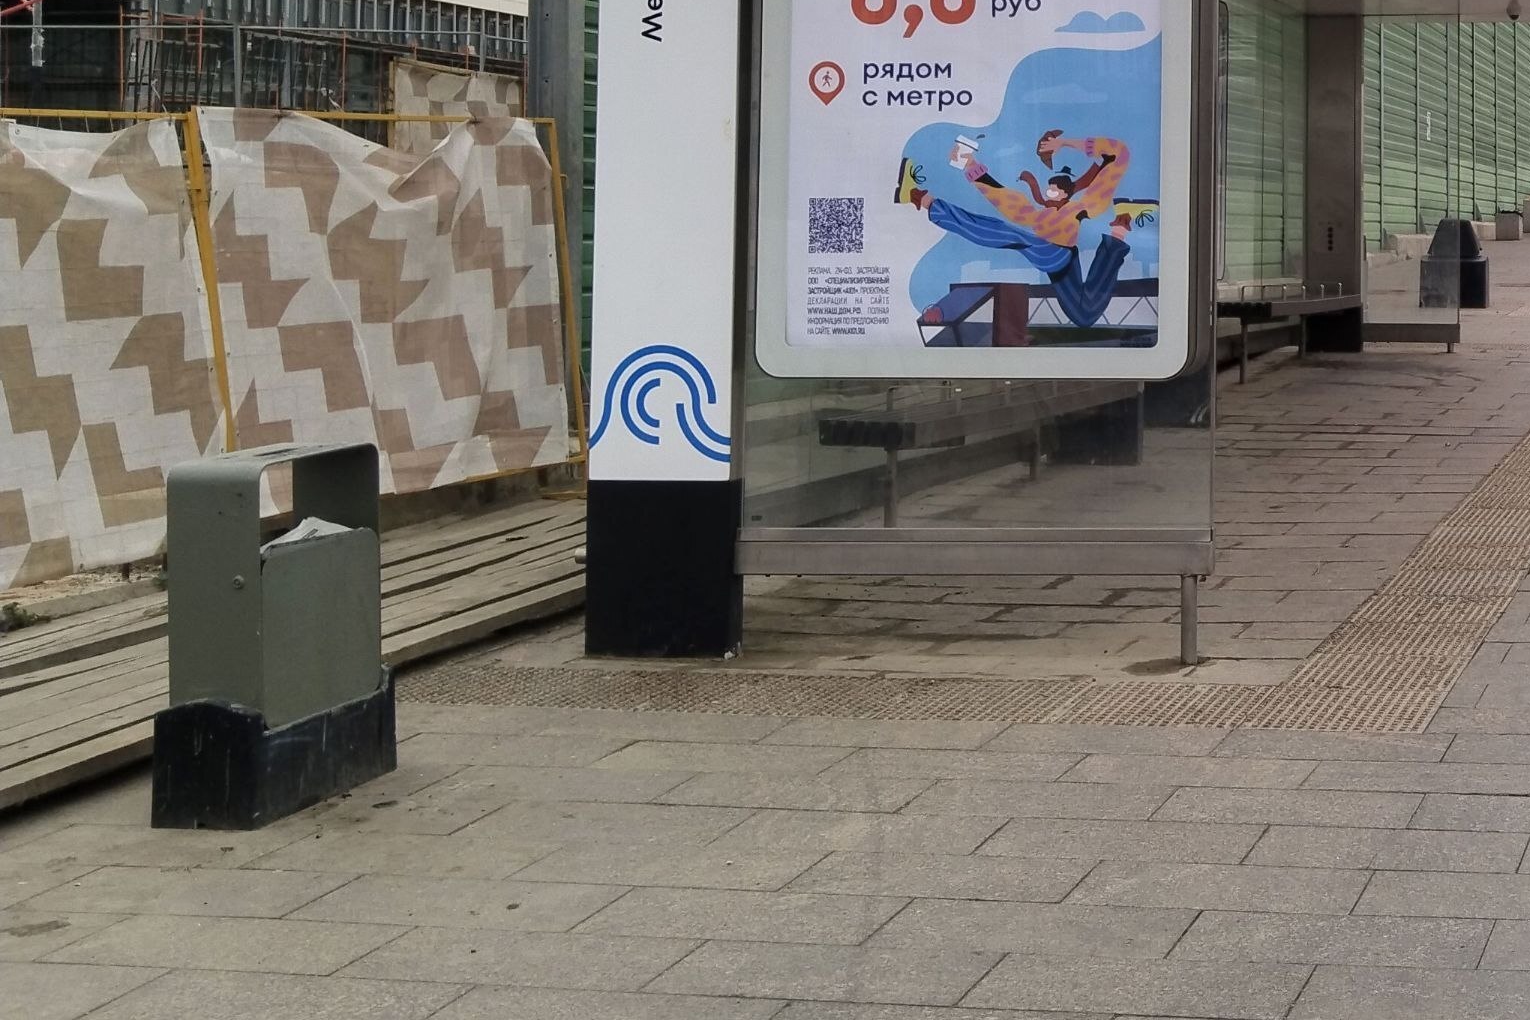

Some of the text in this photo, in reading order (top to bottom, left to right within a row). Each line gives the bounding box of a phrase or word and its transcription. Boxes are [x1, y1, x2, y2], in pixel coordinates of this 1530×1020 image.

[863, 61, 953, 84] рядом
[862, 90, 973, 112] с метро
